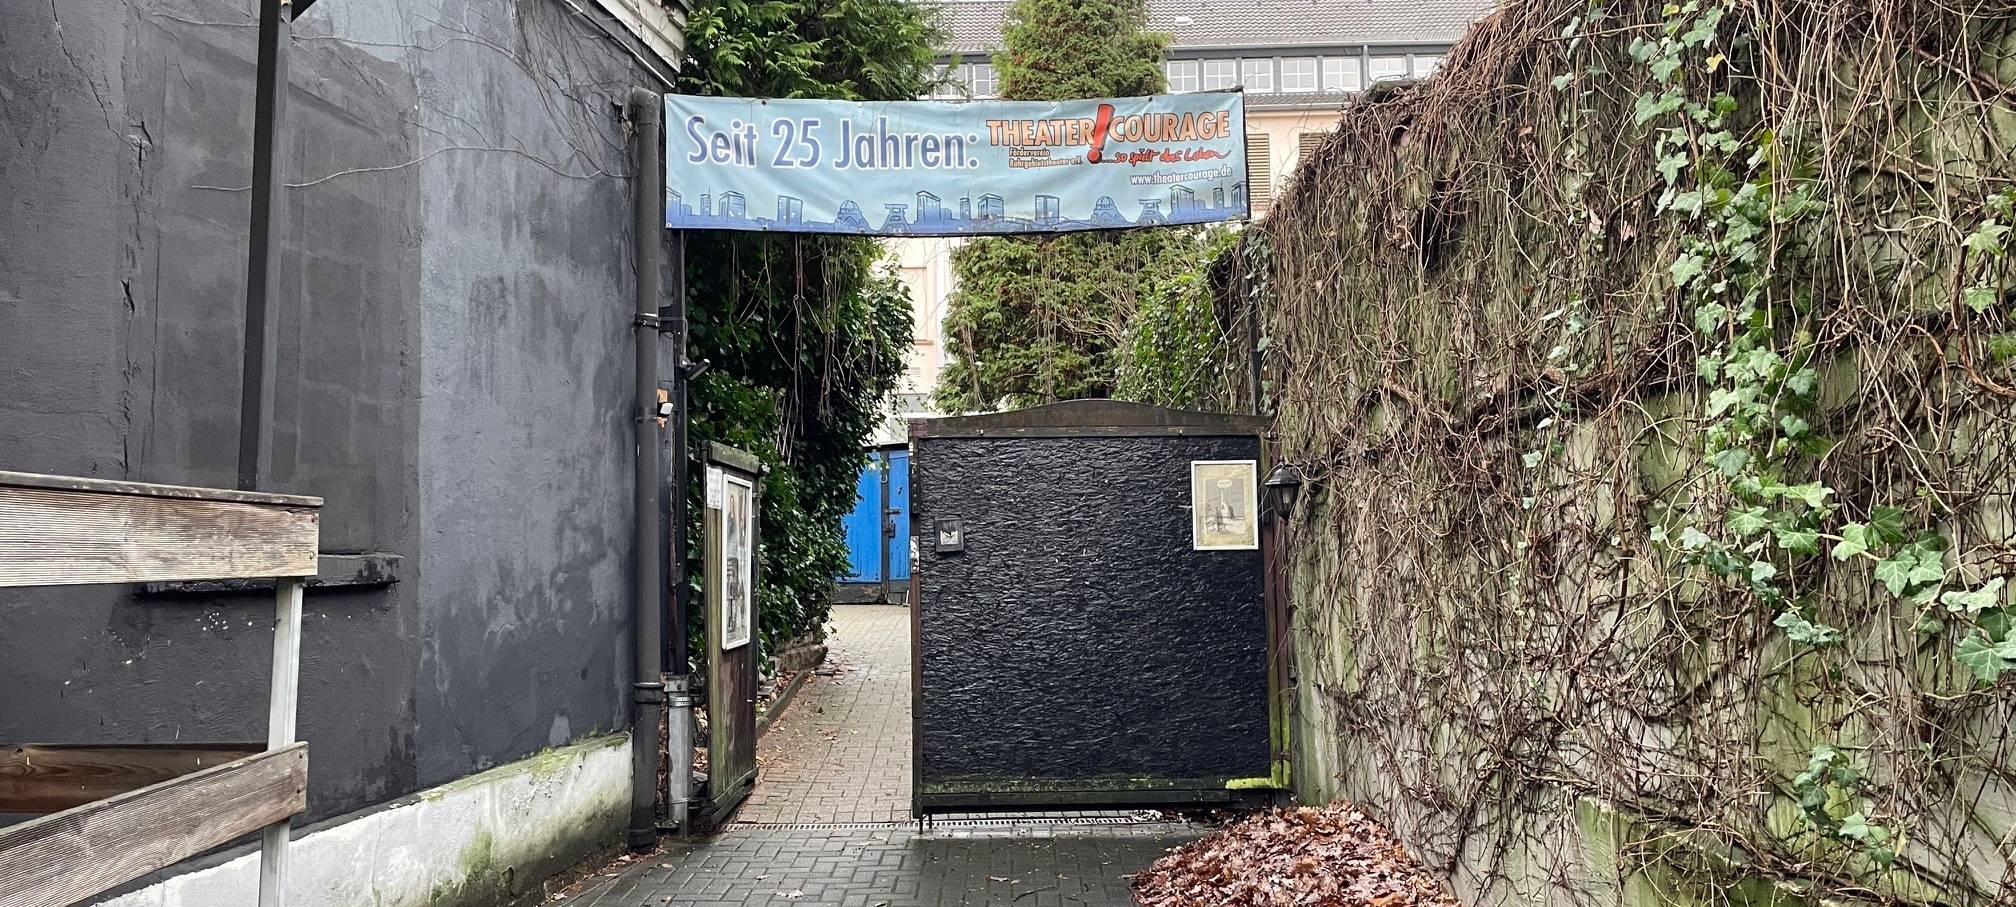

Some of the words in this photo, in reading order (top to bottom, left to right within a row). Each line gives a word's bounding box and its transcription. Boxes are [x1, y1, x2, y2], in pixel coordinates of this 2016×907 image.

[686, 114, 757, 166] Seit
[771, 118, 821, 169] 25
[833, 115, 979, 169] Jahren:
[1009, 158, 1069, 168] Ruhrgebietstheater
[1160, 147, 1183, 162] das
[1184, 147, 1231, 161] Leben
[1130, 164, 1233, 185] www.theatercourage.de
